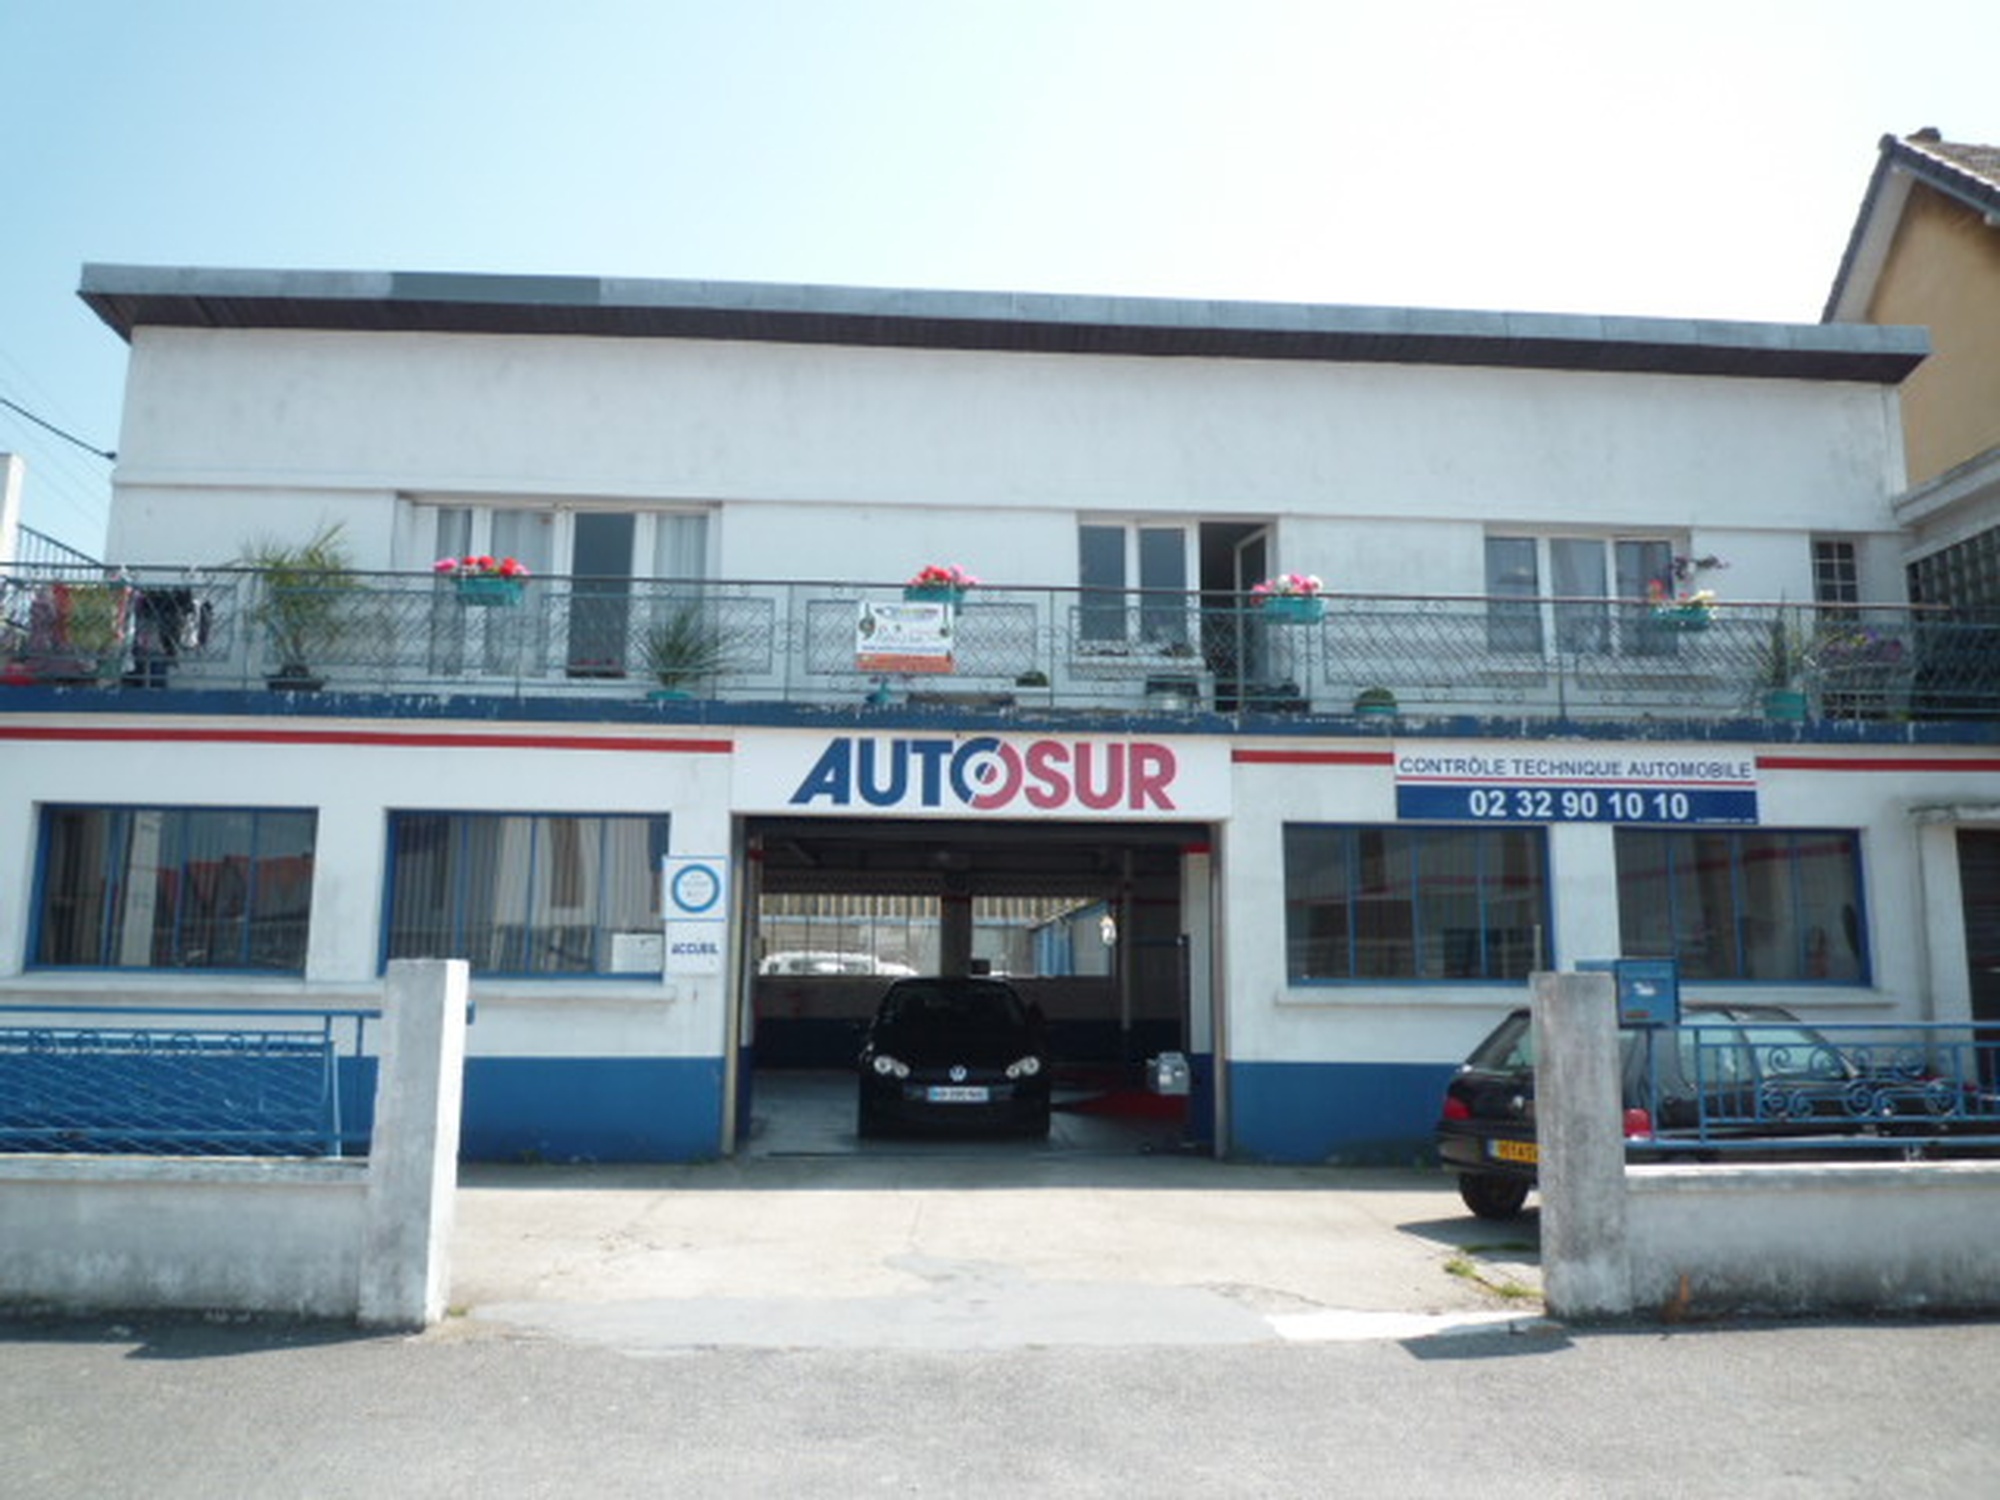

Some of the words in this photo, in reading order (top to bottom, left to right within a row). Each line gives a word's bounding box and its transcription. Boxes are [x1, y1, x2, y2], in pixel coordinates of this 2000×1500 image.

[788, 737, 1177, 811] AUTOSUR
[1399, 755, 1506, 776] CONTRÔLE
[1511, 758, 1622, 777] TECHNIQUE
[1628, 761, 1752, 780] AUTOMOBILE
[1468, 789, 1507, 817] 02
[1516, 790, 1553, 818] 32
[1561, 791, 1599, 819] 90
[1608, 791, 1644, 819] 10
[1653, 792, 1690, 820] 10
[671, 942, 719, 955] ACCUEIL
